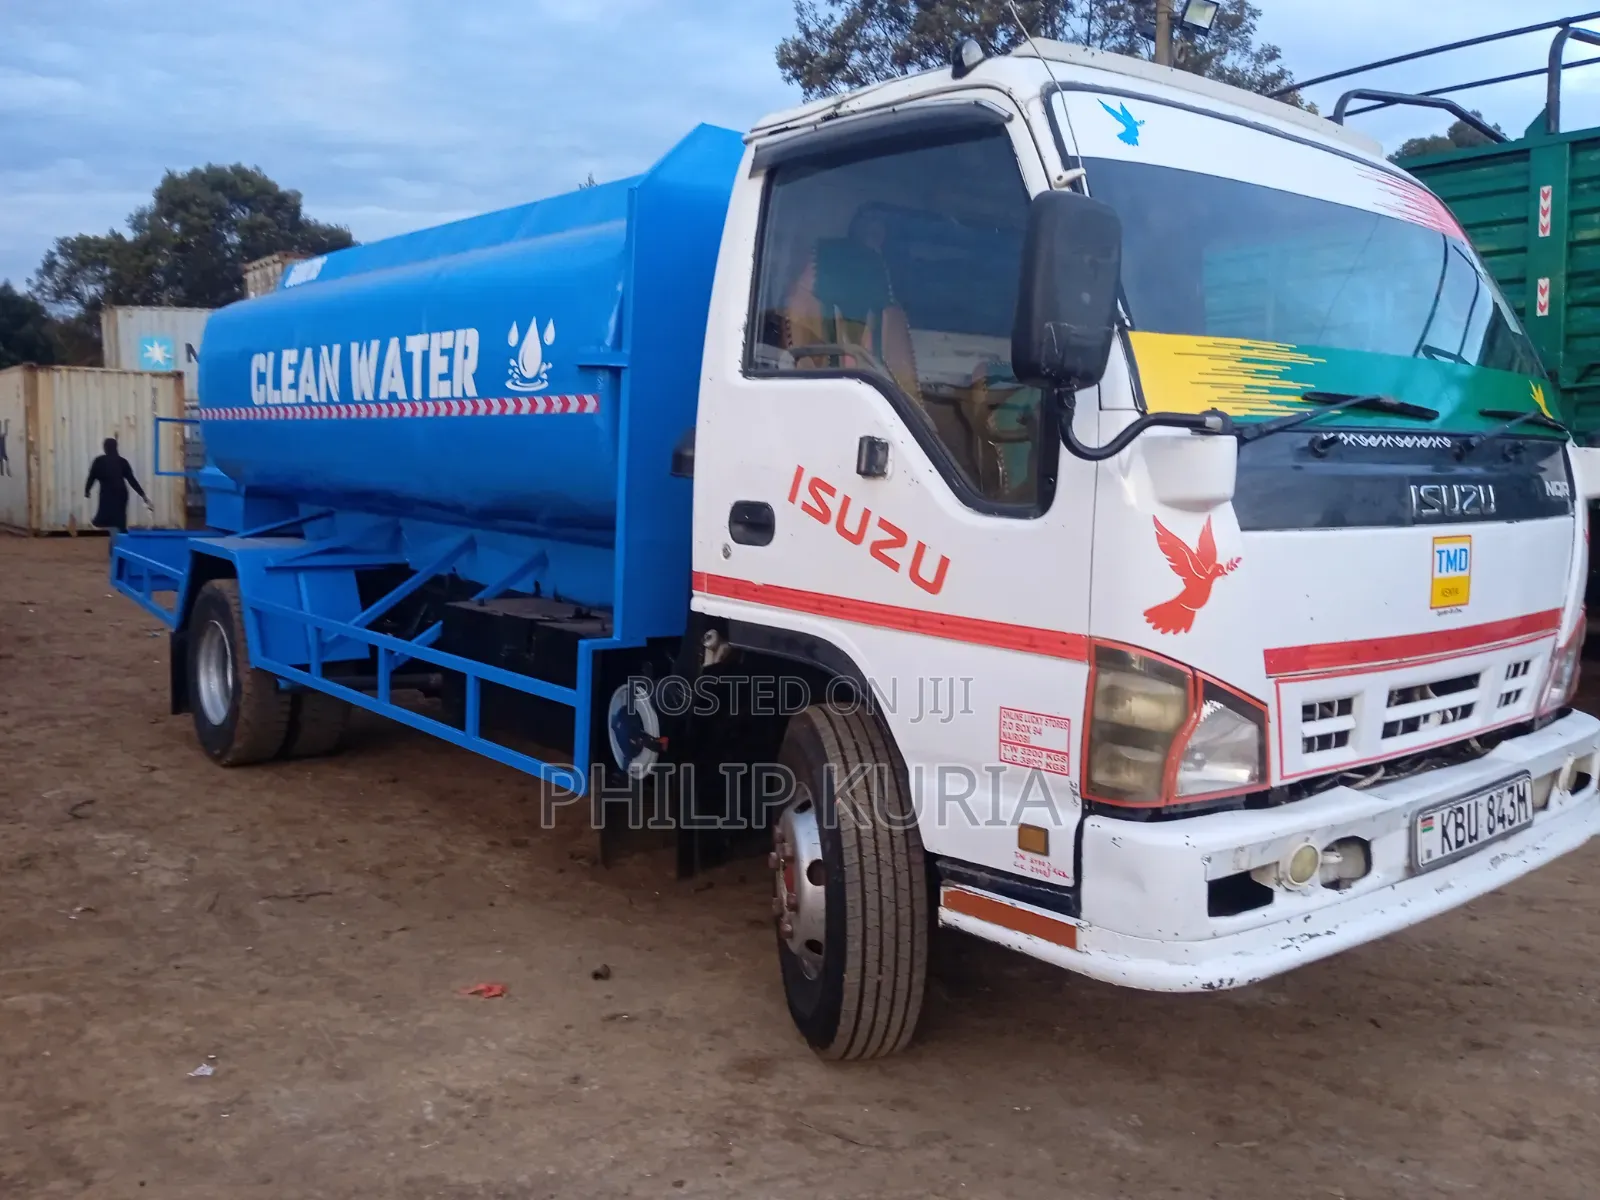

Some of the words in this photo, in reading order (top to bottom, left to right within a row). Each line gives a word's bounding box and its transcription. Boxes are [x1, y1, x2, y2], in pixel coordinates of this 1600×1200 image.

[251, 343, 341, 406] CLEAN
[350, 327, 480, 401] WATER
[1545, 481, 1570, 498] NQR
[1410, 484, 1497, 517] ISUZU
[787, 464, 951, 596] ISUZU
[1436, 548, 1468, 573] TMD
[1002, 710, 1023, 722] ONLINE
[1024, 714, 1043, 726] LUCKY
[1045, 718, 1068, 730] STORES
[1015, 723, 1031, 734] BOX
[1002, 731, 1030, 743] NAIROBI
[1046, 752, 1067, 763] KGS
[1046, 761, 1067, 773] KGS
[1441, 800, 1479, 855] KBU
[1487, 781, 1528, 835] 843M
